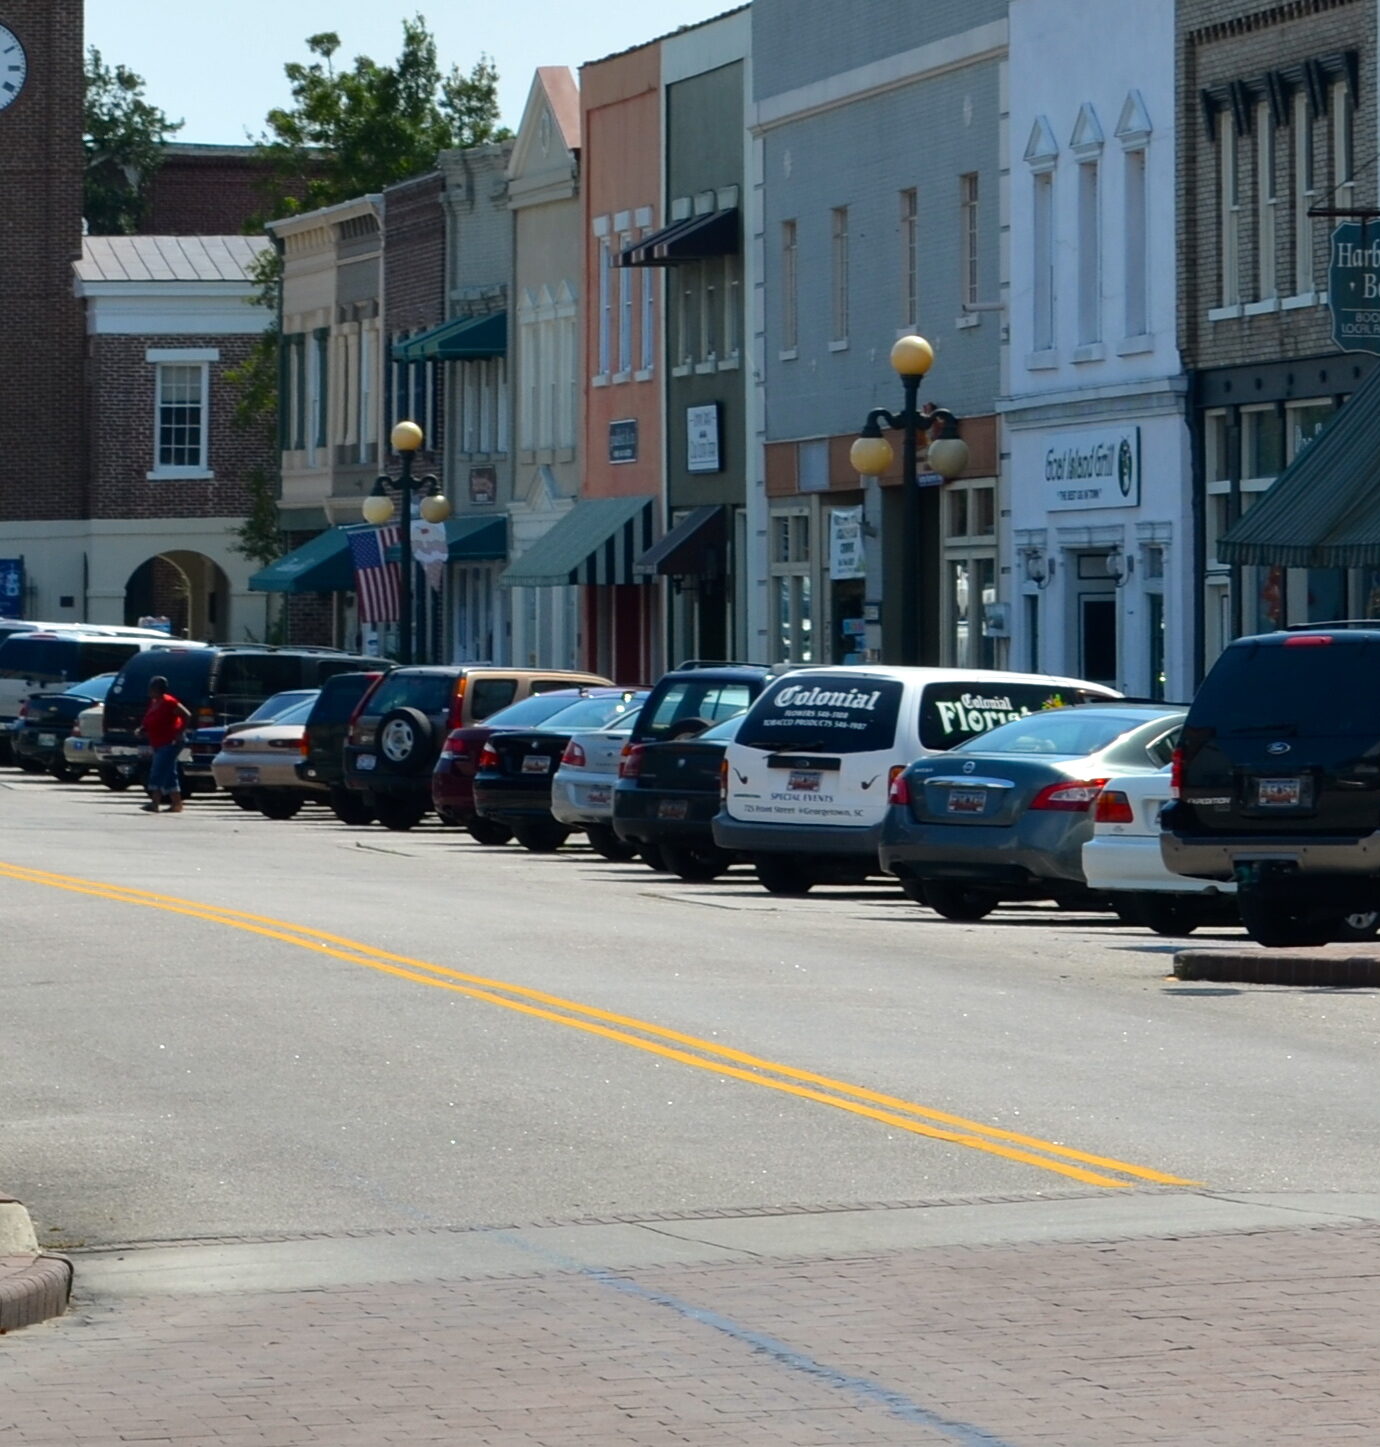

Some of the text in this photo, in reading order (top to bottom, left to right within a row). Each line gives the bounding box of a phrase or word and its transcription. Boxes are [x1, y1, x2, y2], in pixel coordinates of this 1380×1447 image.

[1341, 323, 1372, 333] LOCAL
[774, 684, 881, 711] Colonial
[961, 693, 1014, 710] Colonial
[794, 719, 833, 729] PRODUCTS
[771, 793, 834, 803] SPECIAL EVENTS
